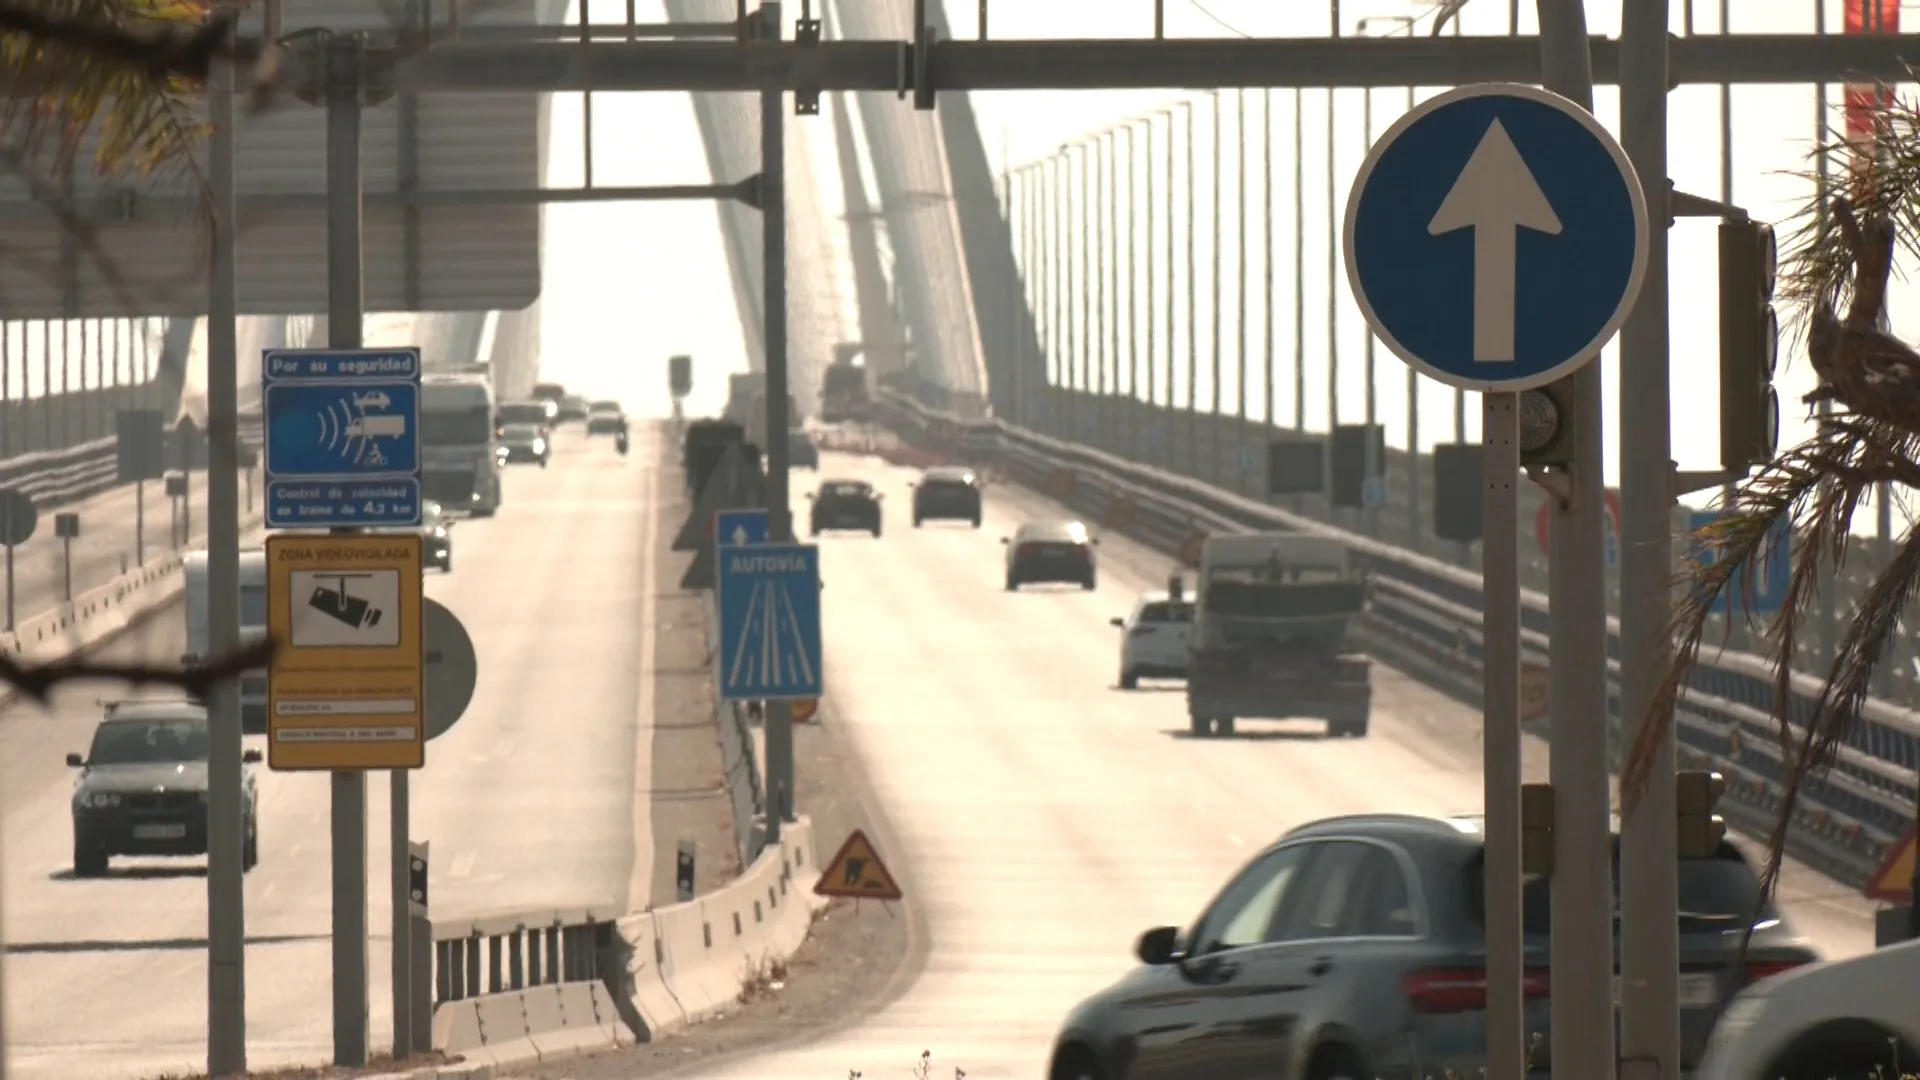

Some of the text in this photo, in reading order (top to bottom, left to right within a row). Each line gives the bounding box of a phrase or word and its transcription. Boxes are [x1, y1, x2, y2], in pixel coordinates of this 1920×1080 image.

[273, 359, 411, 374] Por su seguridad
[277, 486, 407, 499] Control de velocidad
[277, 506, 292, 516] en
[393, 504, 411, 515] km
[277, 547, 412, 561] ZONA VIDEOVIGILADA
